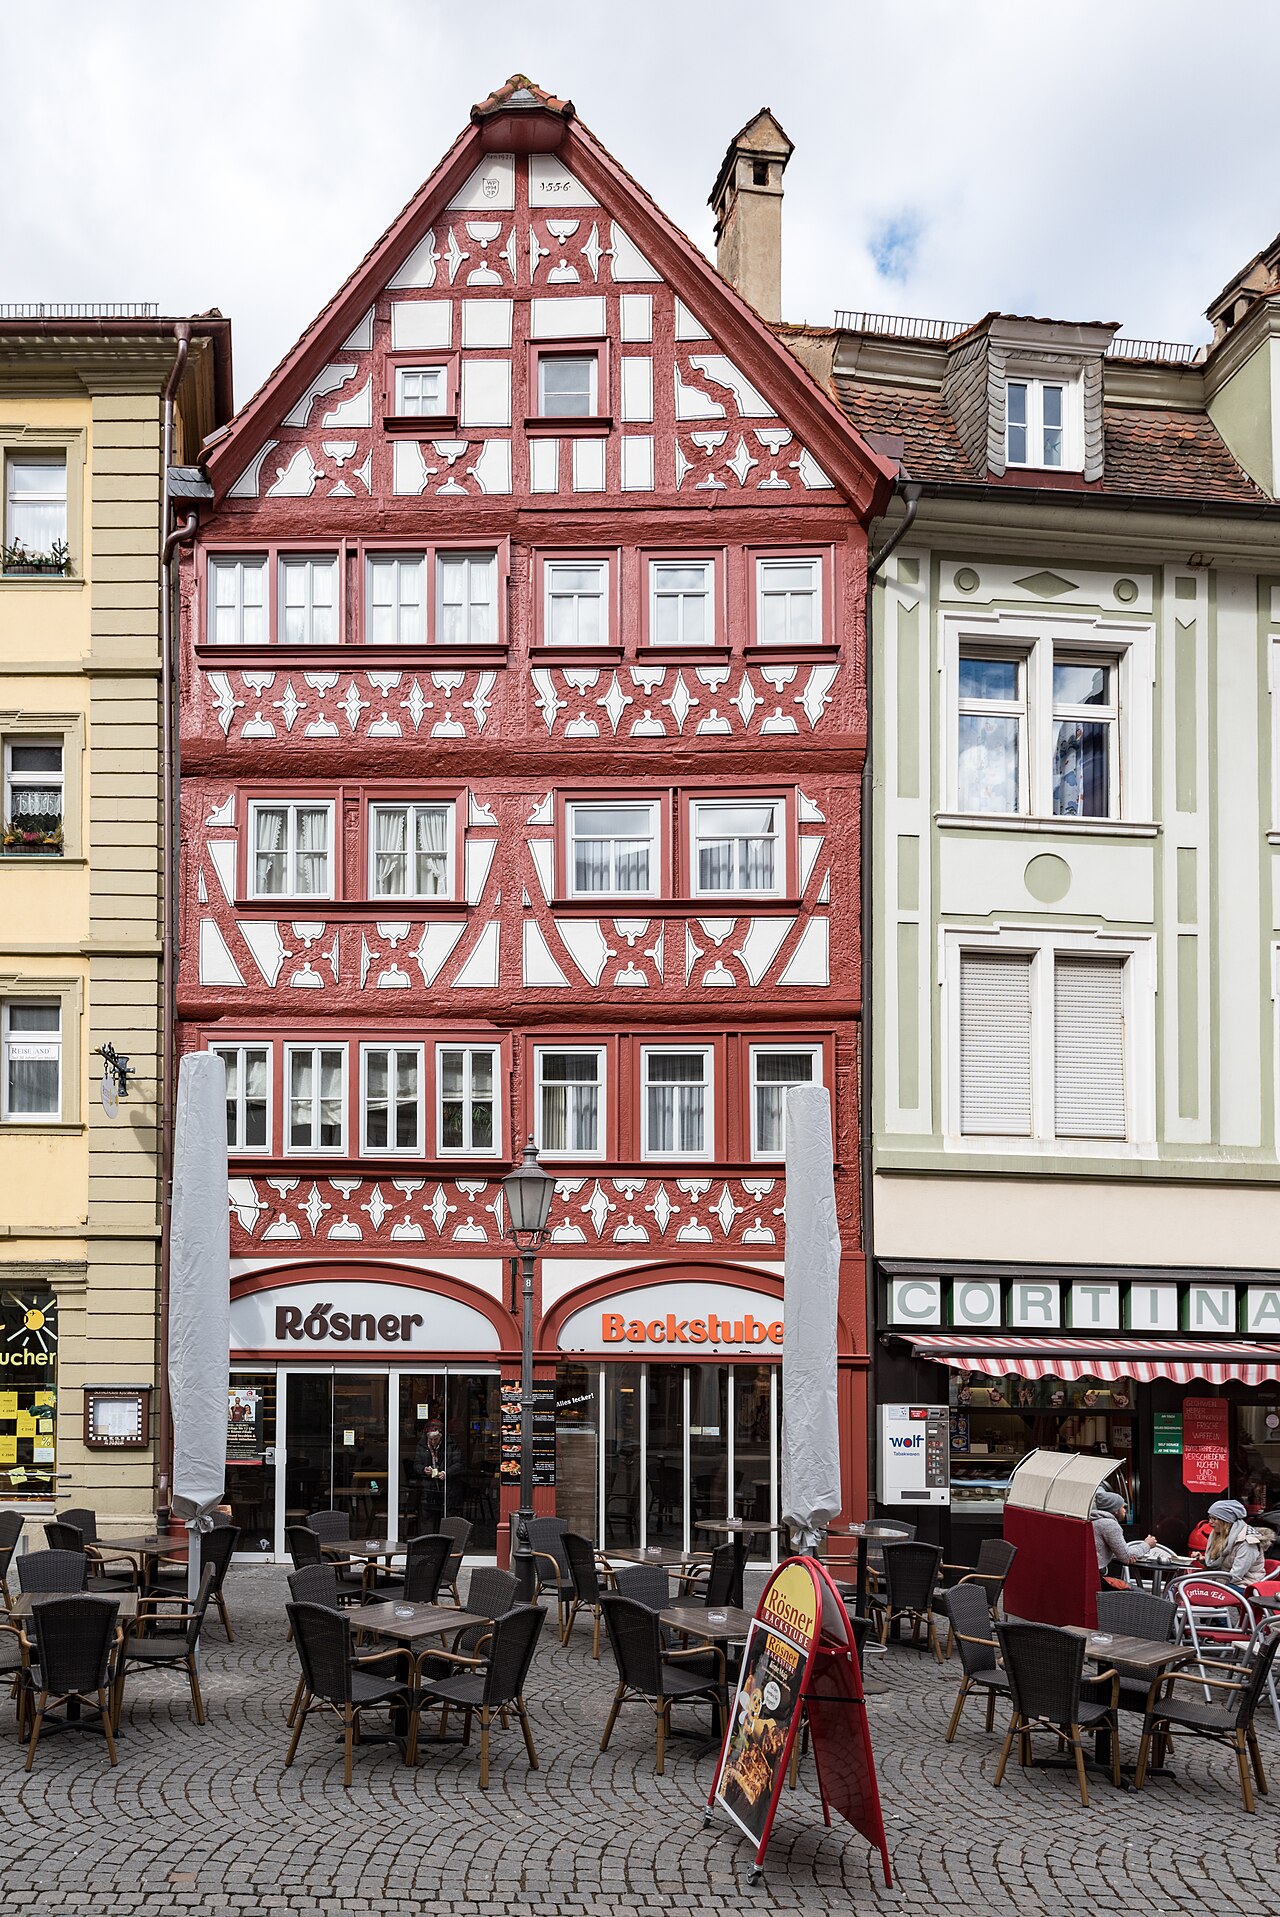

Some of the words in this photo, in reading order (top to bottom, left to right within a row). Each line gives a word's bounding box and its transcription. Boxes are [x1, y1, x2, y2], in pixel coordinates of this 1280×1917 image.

[525, 1278, 532, 1288] 8
[896, 1281, 1280, 1328] CORTINA
[601, 1312, 785, 1344] Backstube
[556, 1399, 572, 1408] Alles
[572, 1392, 595, 1403] lecker!
[889, 1434, 925, 1448] wolf
[1184, 1452, 1227, 1461] VERSCHIEDENE
[1196, 1461, 1219, 1469] KUCHEN
[1199, 1468, 1213, 1476] UND
[1186, 1588, 1209, 1598] Cortina
[1210, 1591, 1226, 1601] Eis
[767, 1588, 813, 1634] Rösner
[764, 1611, 809, 1647] BACKSTUBE
[768, 1636, 797, 1666] Rösner
